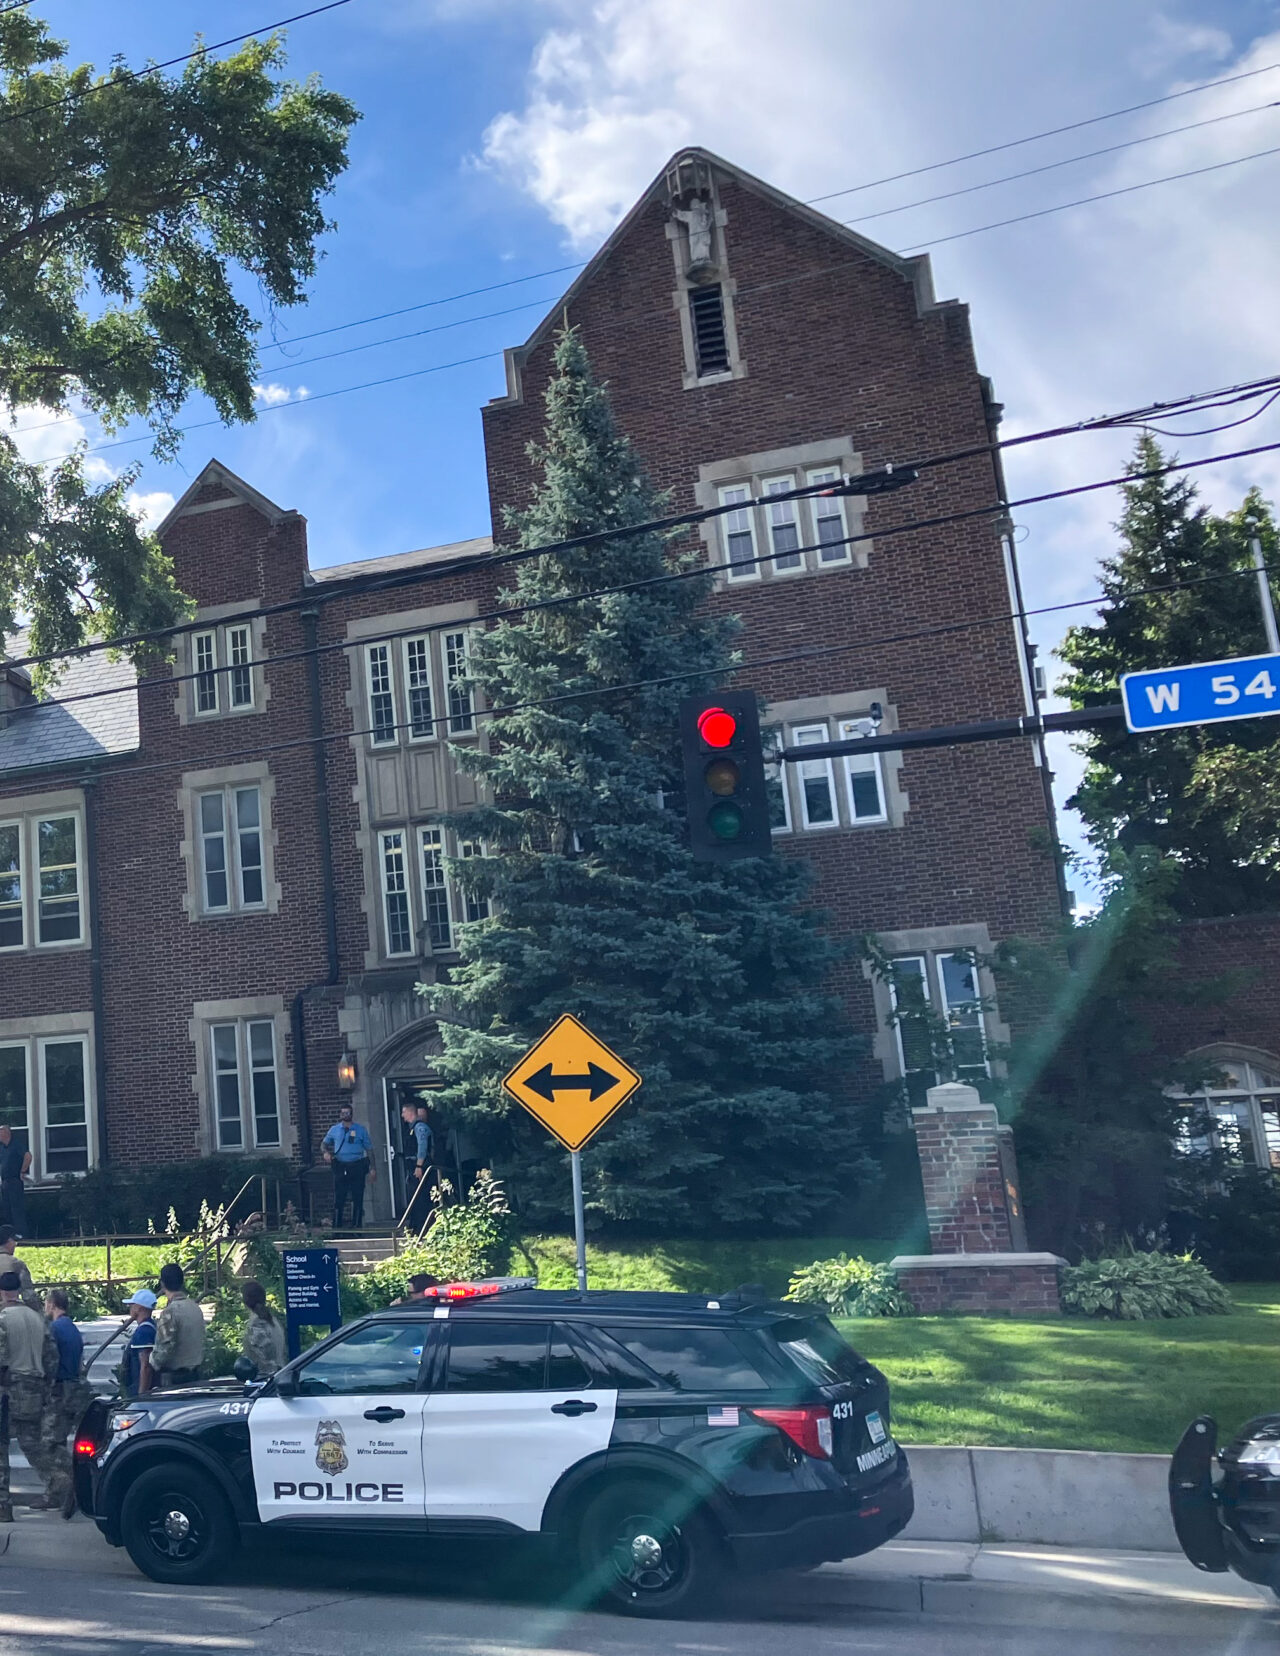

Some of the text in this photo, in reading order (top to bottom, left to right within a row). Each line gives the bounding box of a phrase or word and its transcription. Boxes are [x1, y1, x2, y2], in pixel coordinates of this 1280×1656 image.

[1145, 669, 1277, 714] W 54
[285, 1255, 307, 1263] School
[219, 1402, 252, 1416] 431
[833, 1400, 853, 1420] 431
[273, 1481, 404, 1503] POLICE
